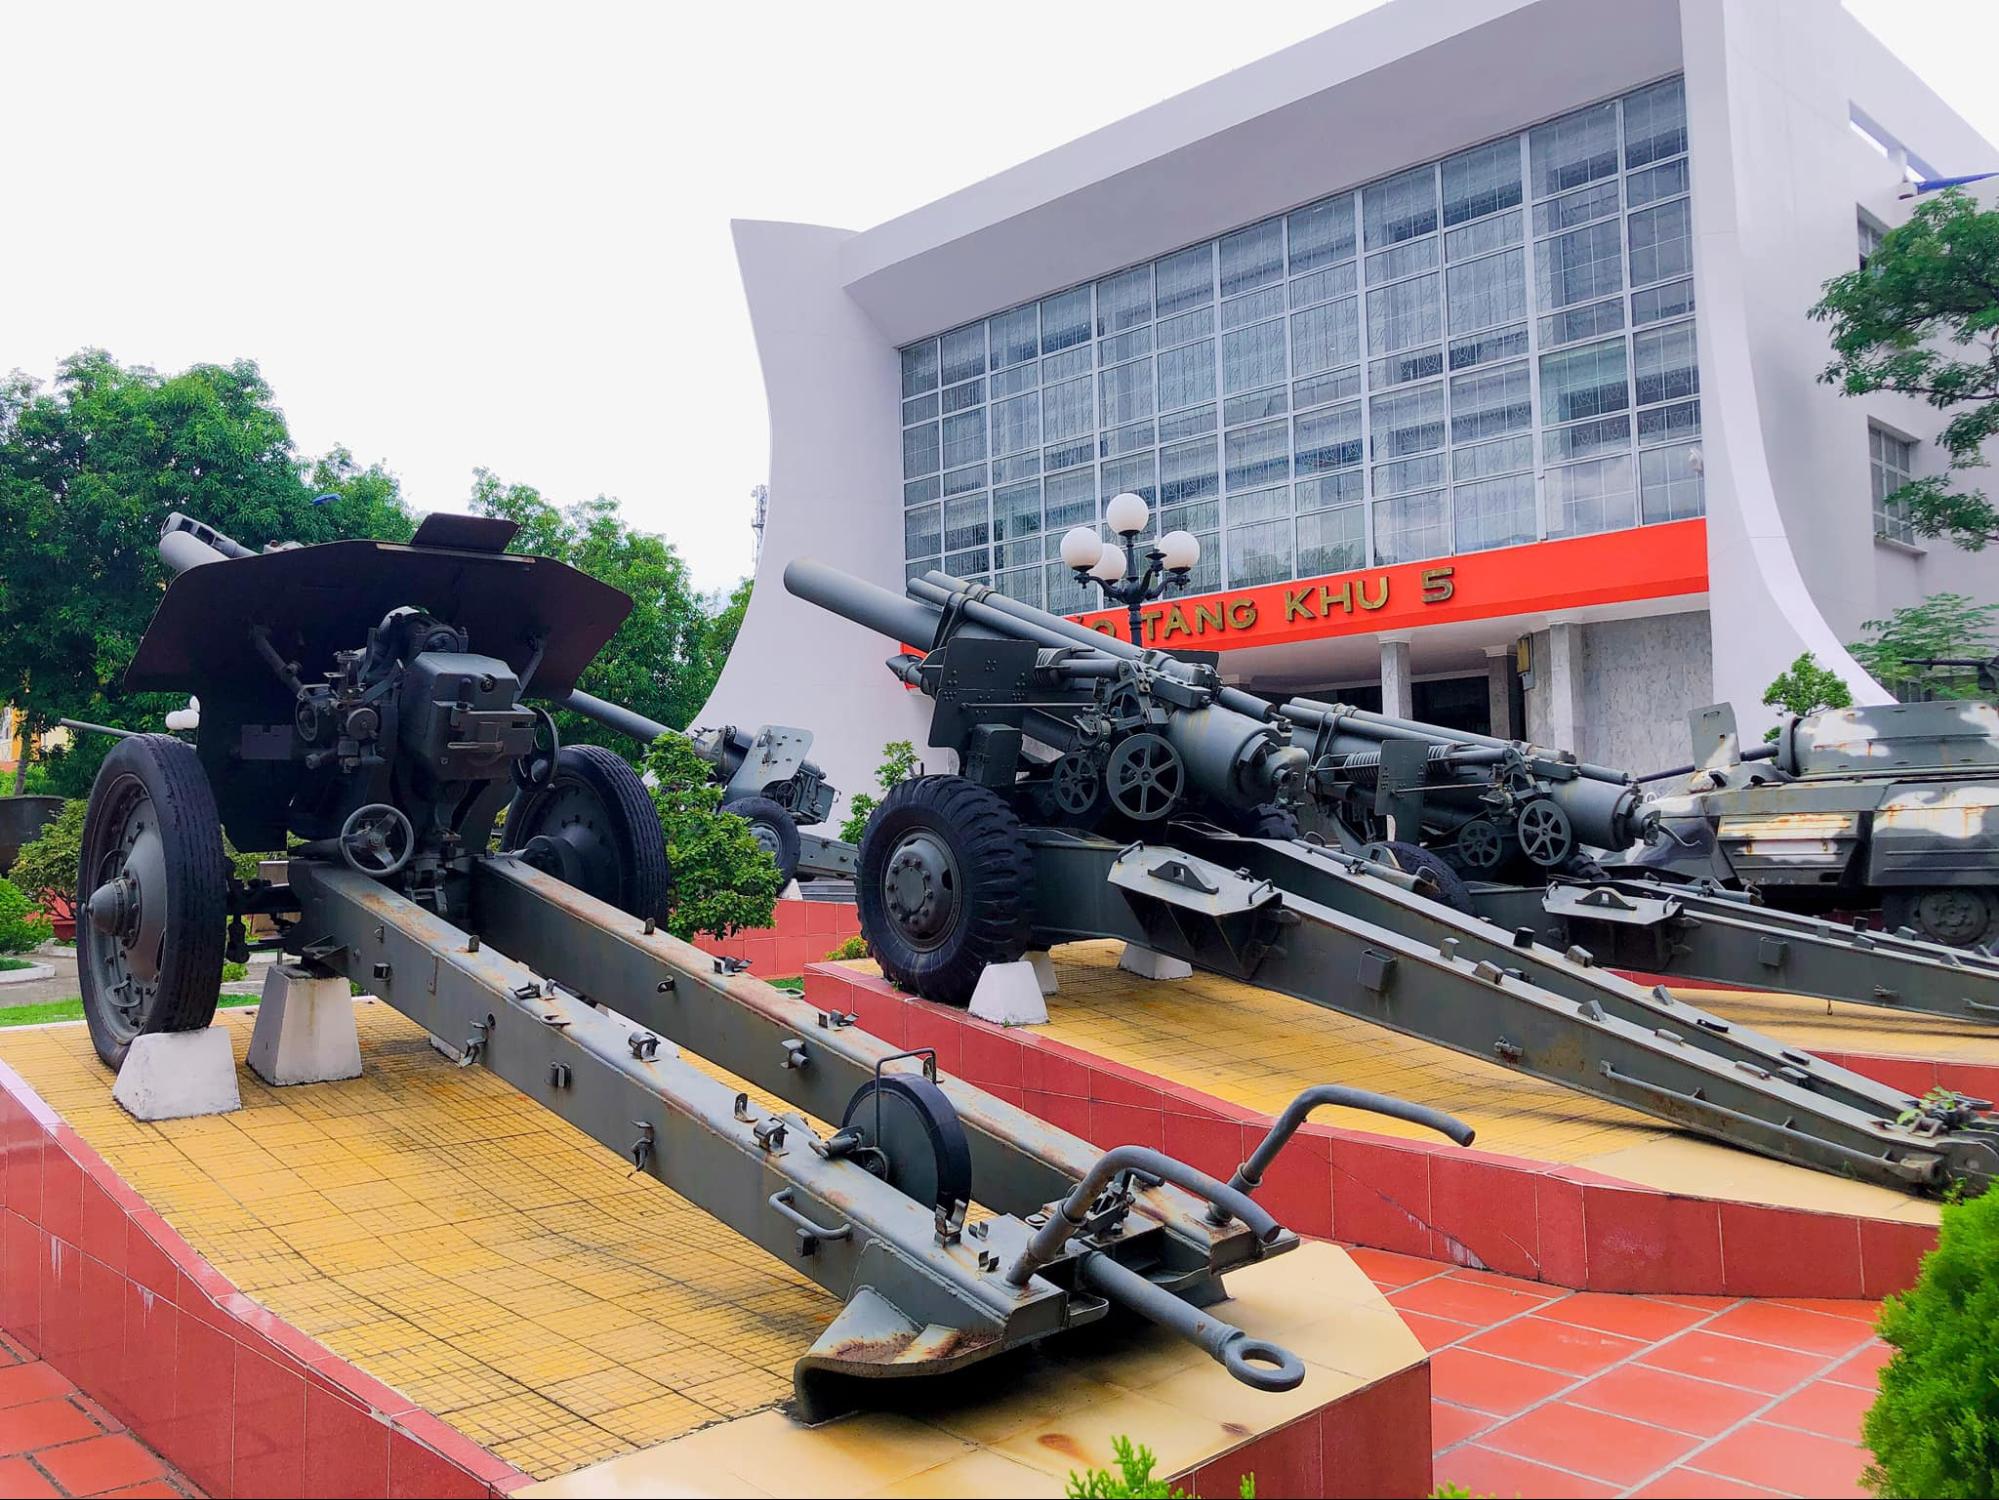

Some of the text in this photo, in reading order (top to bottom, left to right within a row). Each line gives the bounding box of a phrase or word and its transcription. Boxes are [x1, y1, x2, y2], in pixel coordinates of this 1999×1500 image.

[1141, 598, 1257, 641] TÀNG
[1284, 576, 1389, 621] KHU
[1421, 567, 1455, 603] 5
